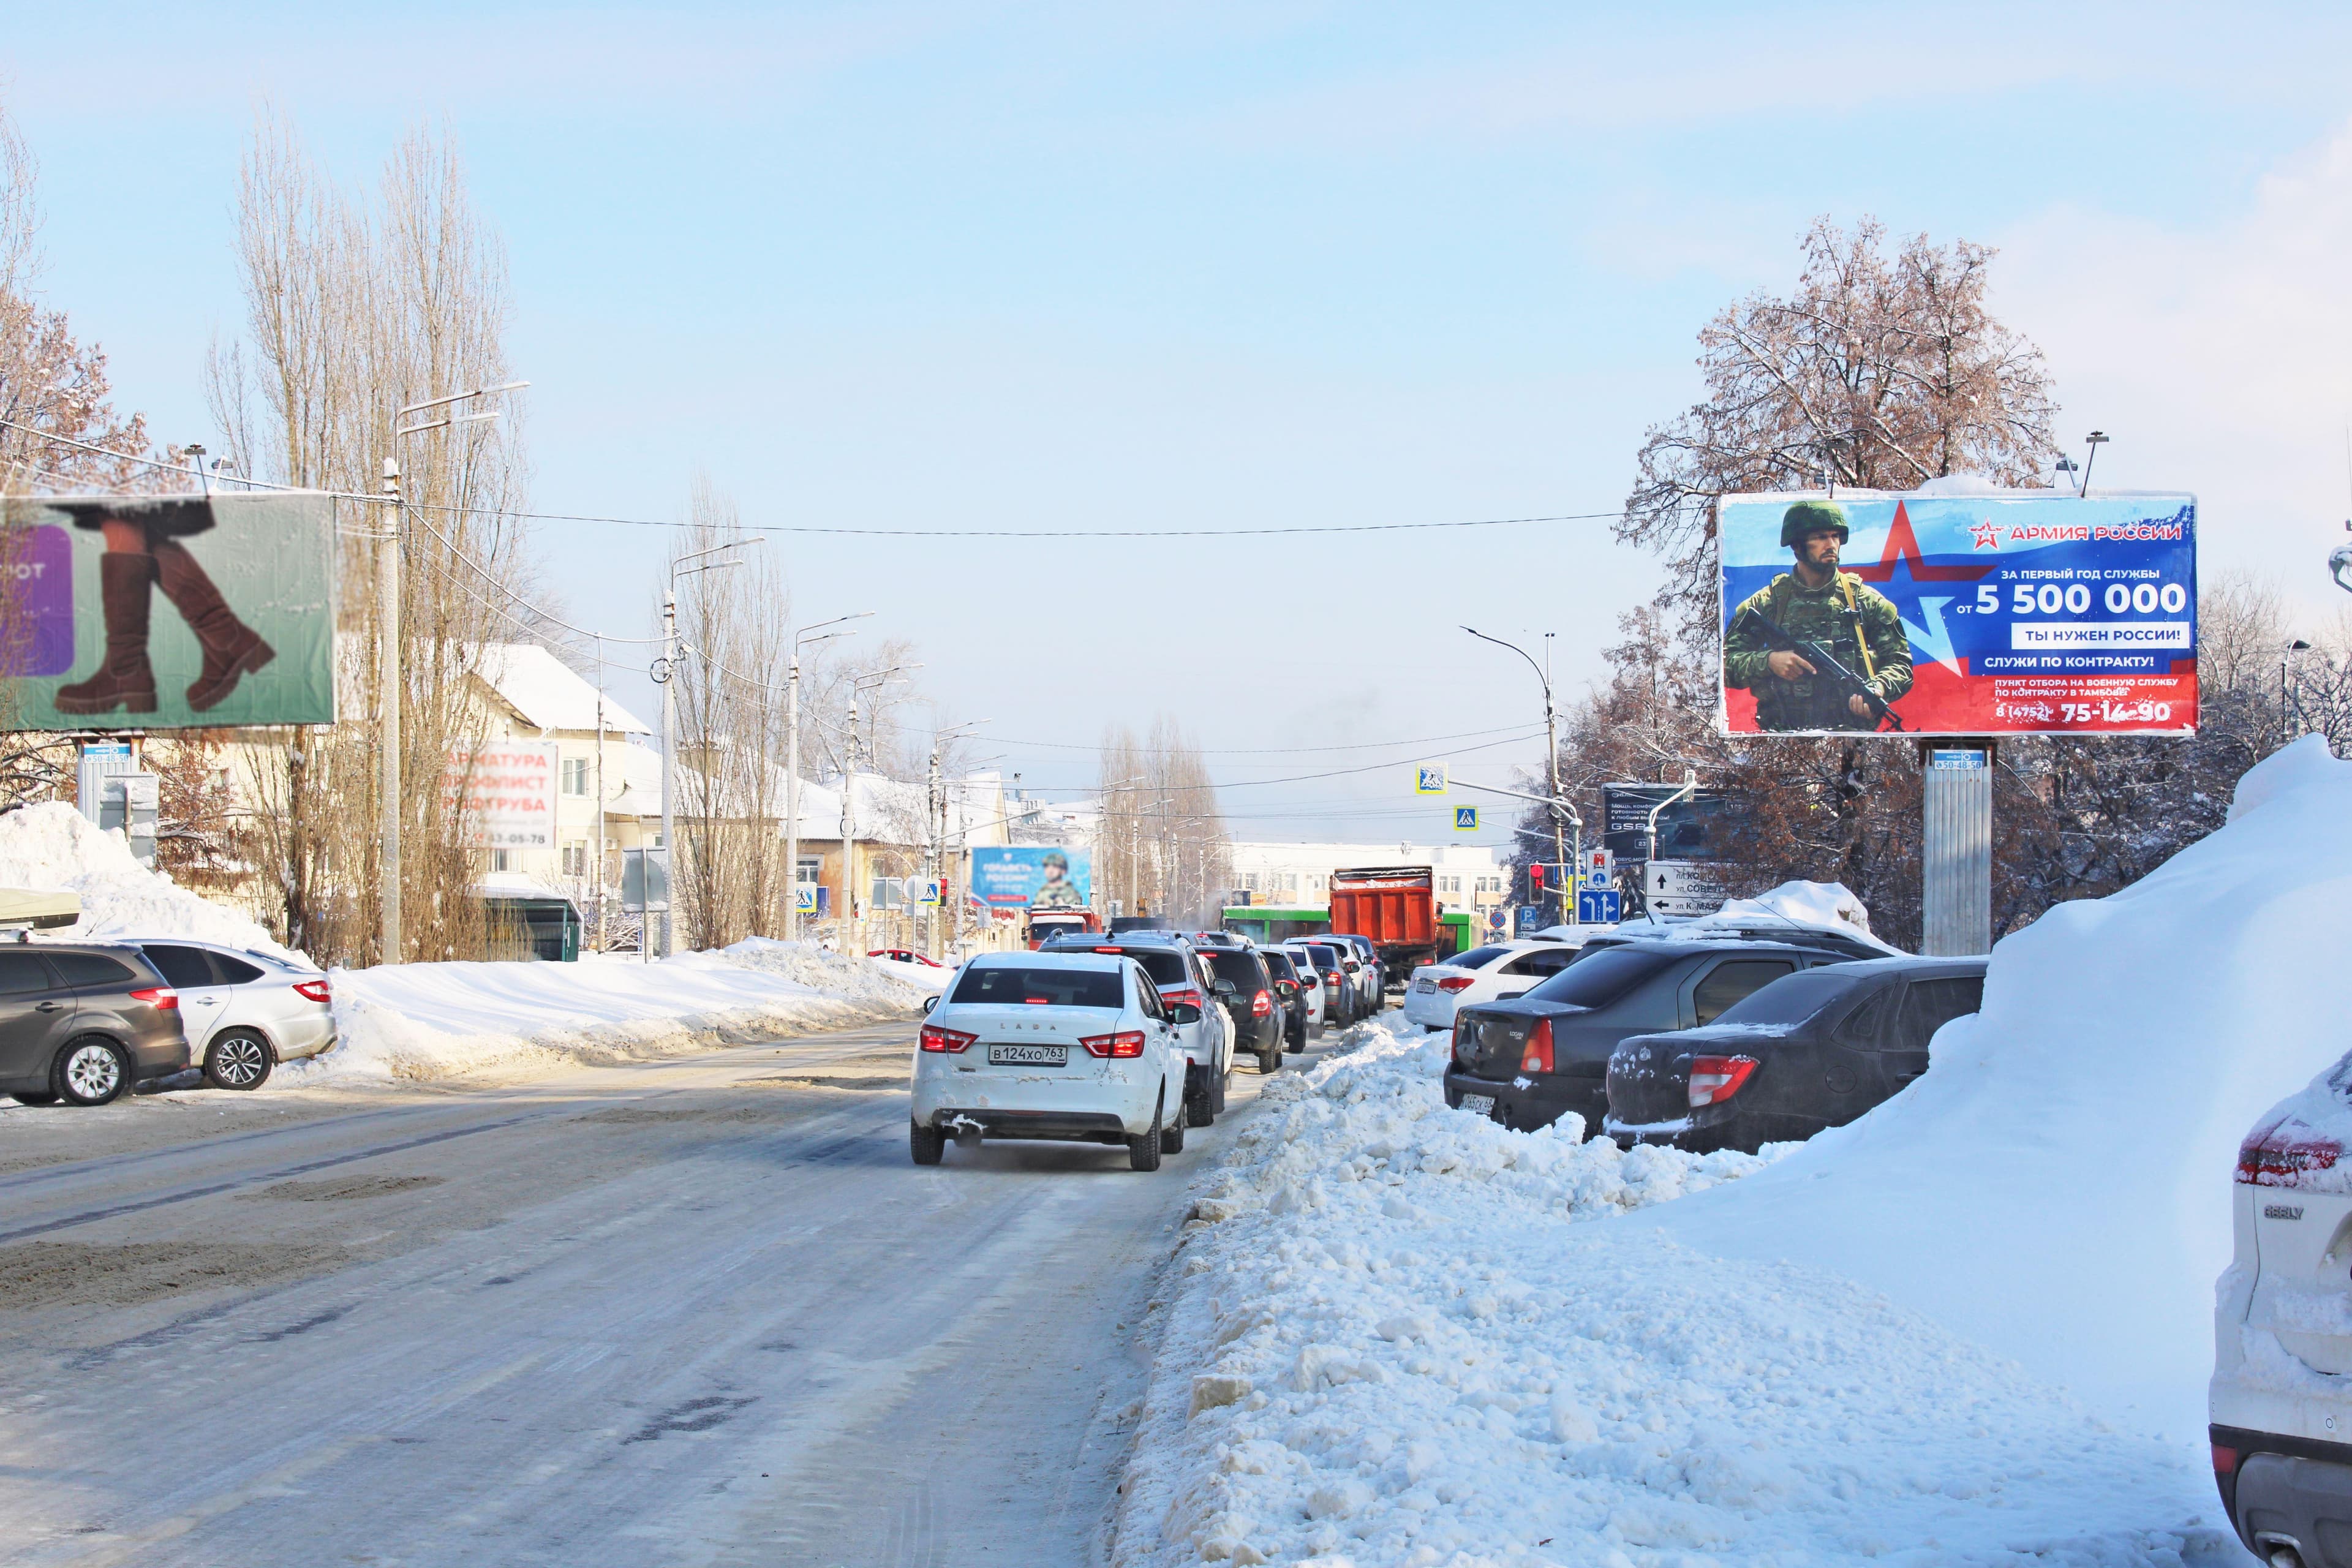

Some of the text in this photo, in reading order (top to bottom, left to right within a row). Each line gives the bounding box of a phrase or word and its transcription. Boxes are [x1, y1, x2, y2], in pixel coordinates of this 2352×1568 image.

[2010, 525, 2182, 541] АРМИЯ РОССИИ
[2001, 568, 2160, 581] ЗА ПЕРВЫЙ ГОД СЛУЖБЫ
[1975, 585, 2000, 614] 5
[2012, 583, 2091, 614] 500
[2104, 583, 2186, 614] 000
[2026, 630, 2180, 641] ТЫ НУЖЕН РОССИИ!
[1985, 657, 2154, 668] СЛУЖИ ПО КОНТРАКТУ!
[1996, 703, 2171, 722] 8 (4752) 75-14-90
[1000, 1022, 1057, 1031] LADA
[993, 1047, 1063, 1060] В124ХО 763
[2264, 1205, 2304, 1220] GEELY
